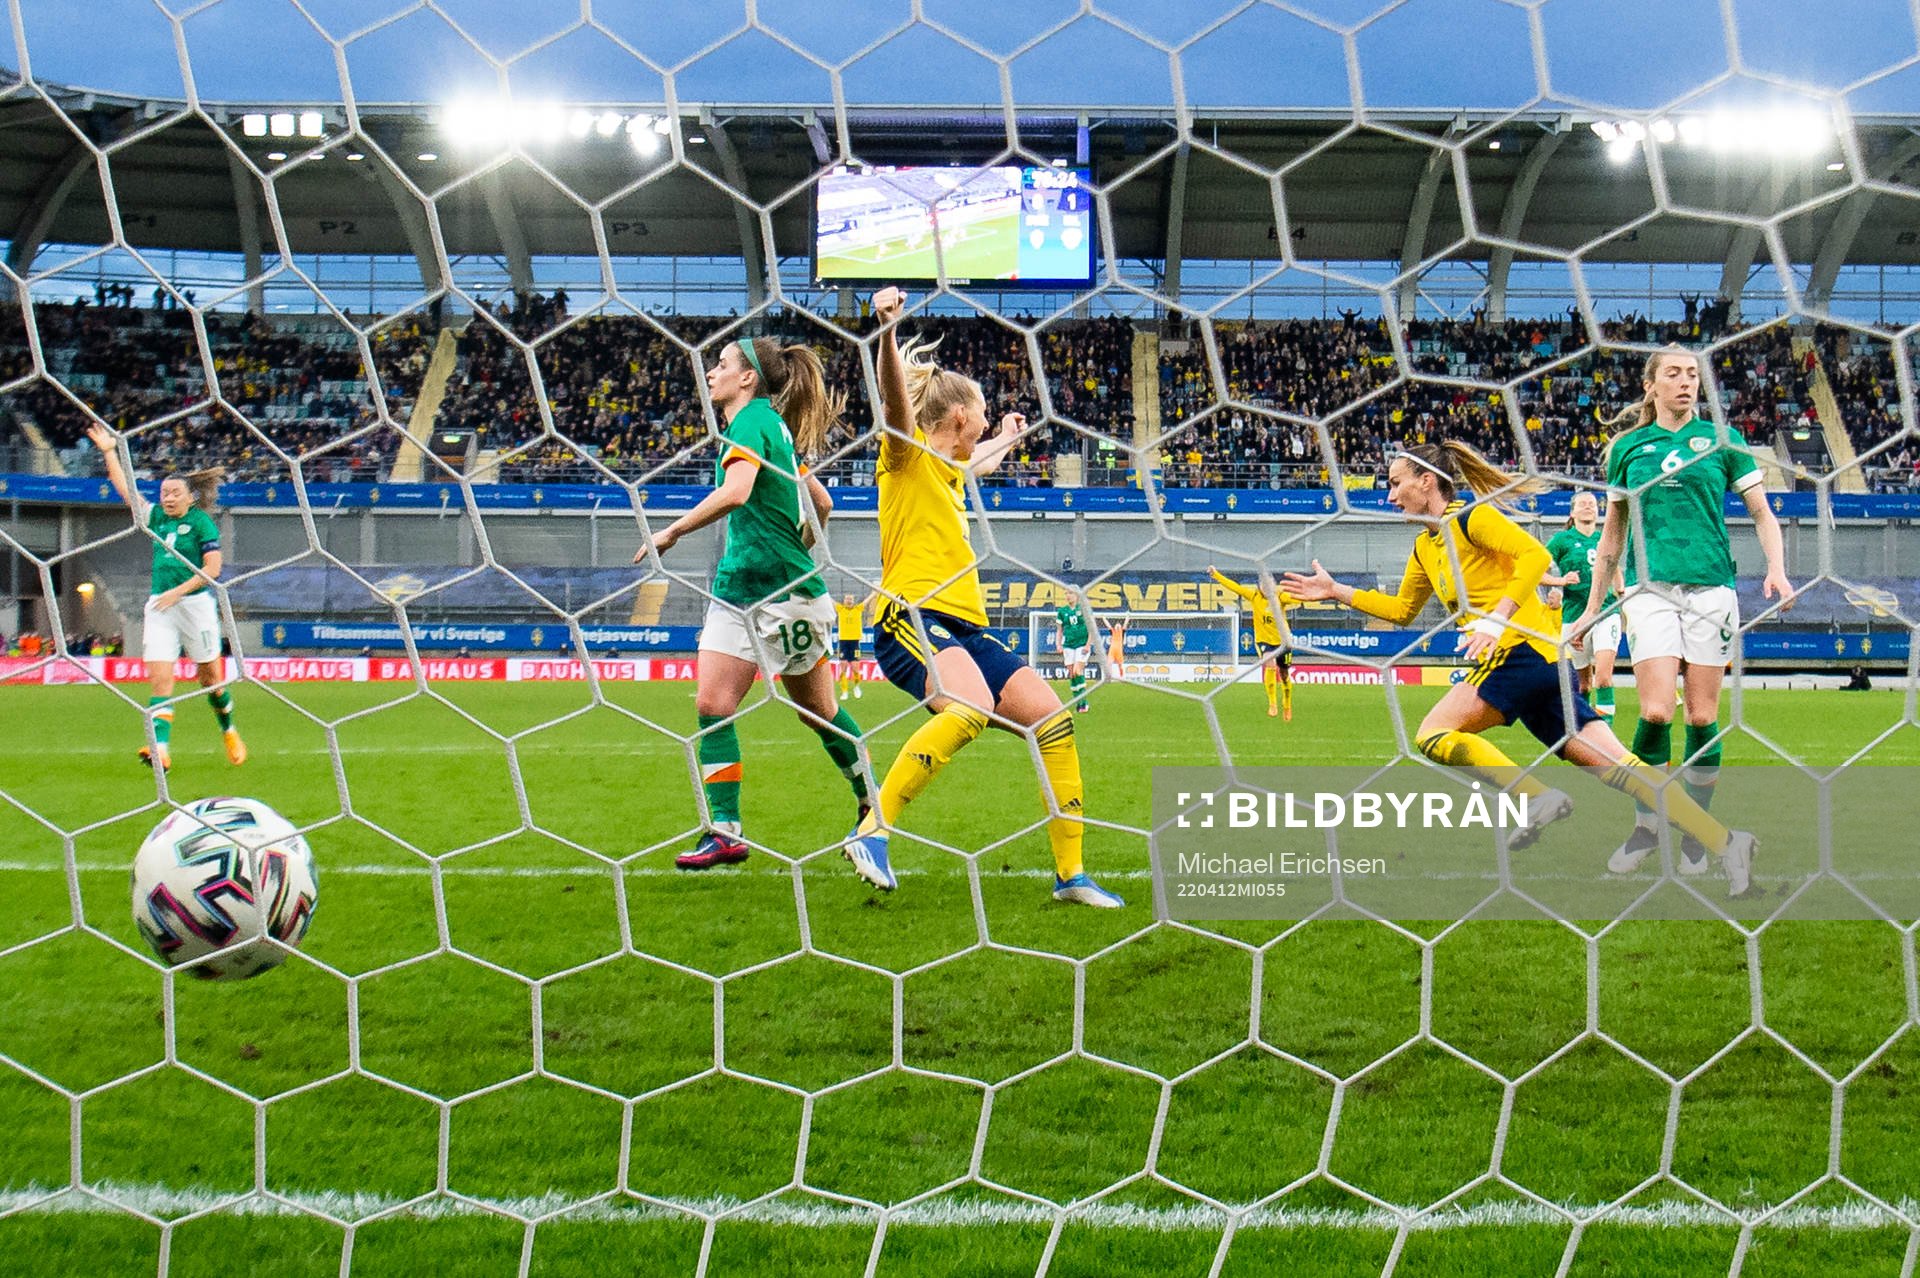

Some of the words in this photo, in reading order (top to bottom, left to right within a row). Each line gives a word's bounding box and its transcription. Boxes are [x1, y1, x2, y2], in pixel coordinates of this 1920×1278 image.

[1066, 192, 1077, 211] 1
[319, 220, 358, 235] P2
[611, 222, 649, 235] P3
[1661, 449, 1683, 474] 6
[313, 626, 411, 640] Tillsamman
[429, 626, 446, 641] vi
[446, 626, 506, 644] Sverige
[778, 618, 813, 657] 18
